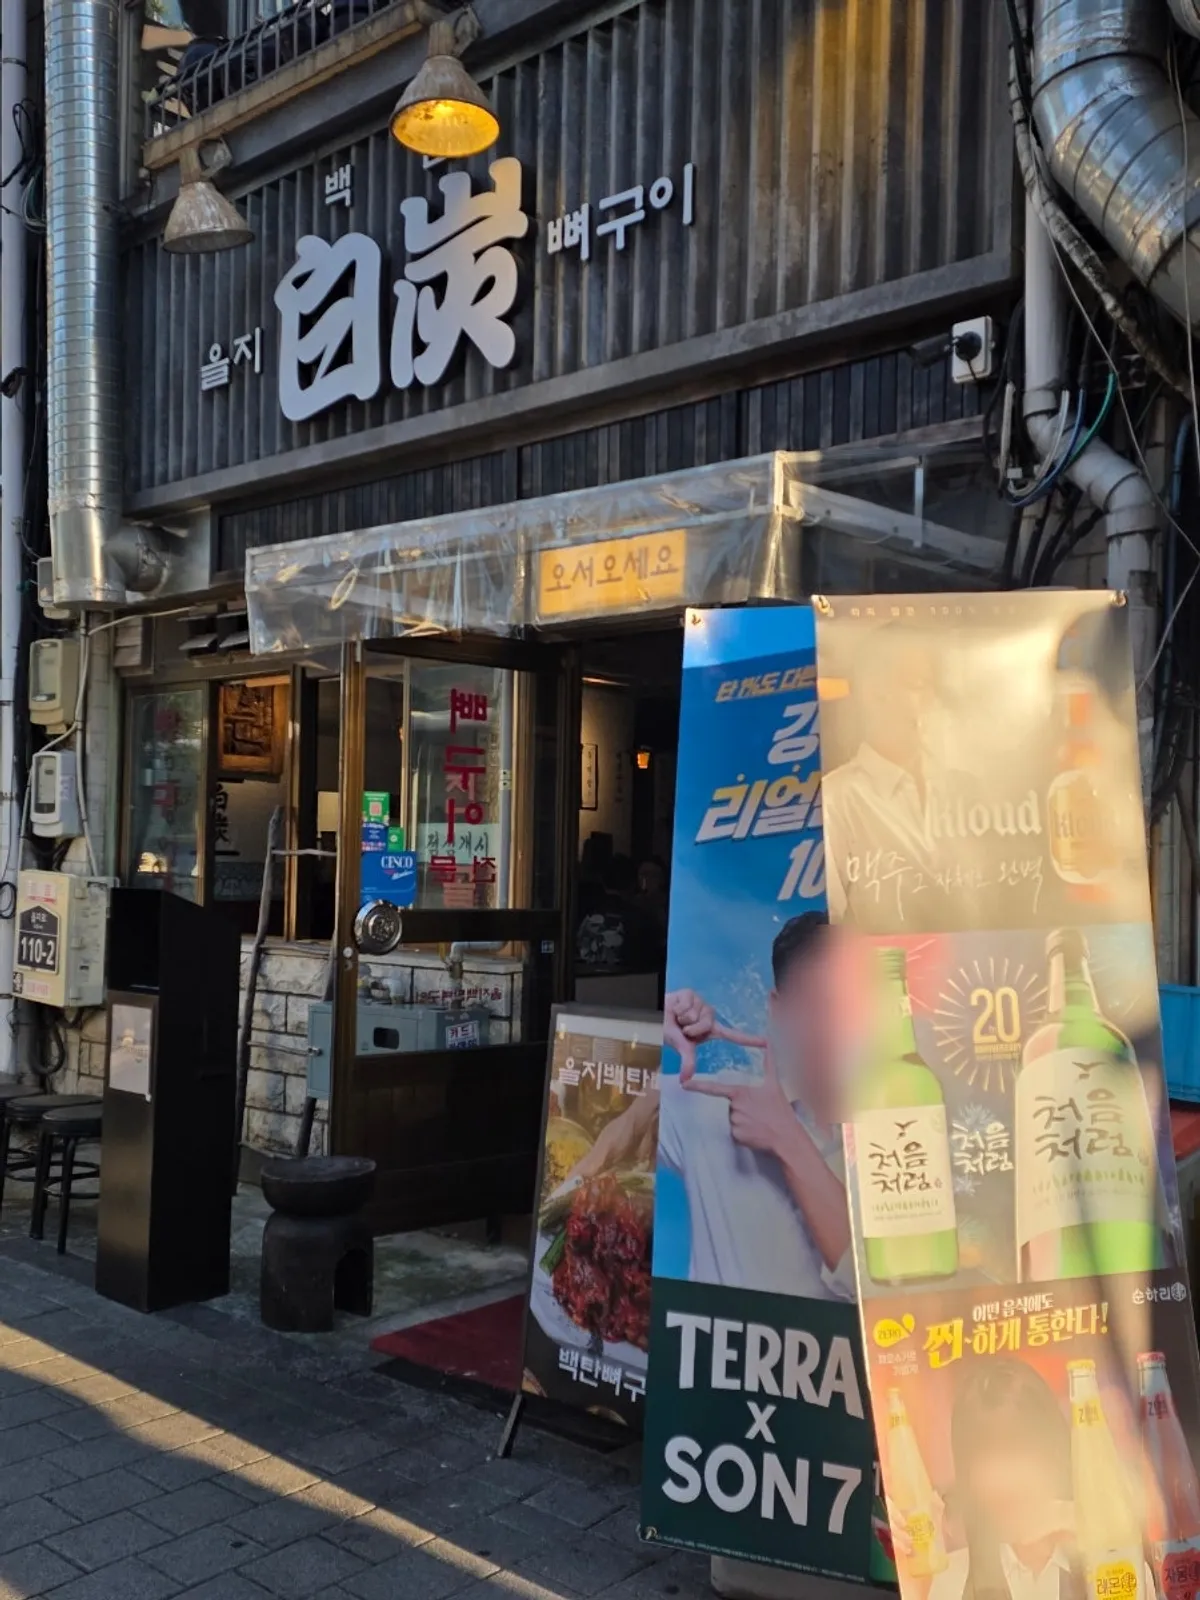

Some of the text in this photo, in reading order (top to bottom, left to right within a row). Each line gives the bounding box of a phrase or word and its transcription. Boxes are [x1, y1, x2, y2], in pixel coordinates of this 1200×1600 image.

[325, 164, 351, 206] 백
[547, 162, 694, 260] 뼈구이
[201, 327, 261, 390] 을지
[695, 765, 823, 843] 리얼
[21, 936, 55, 966] 110-2
[970, 987, 1021, 1043] 20
[868, 1141, 928, 1170] 처음
[952, 1120, 1010, 1151] 처음
[870, 1171, 932, 1195] 처럼
[953, 1151, 1015, 1176] 처럼
[1026, 1302, 1109, 1348] 통한다!
[666, 1311, 865, 1420] TERRA
[661, 1434, 810, 1527] SON
[822, 1461, 862, 1535] 7
